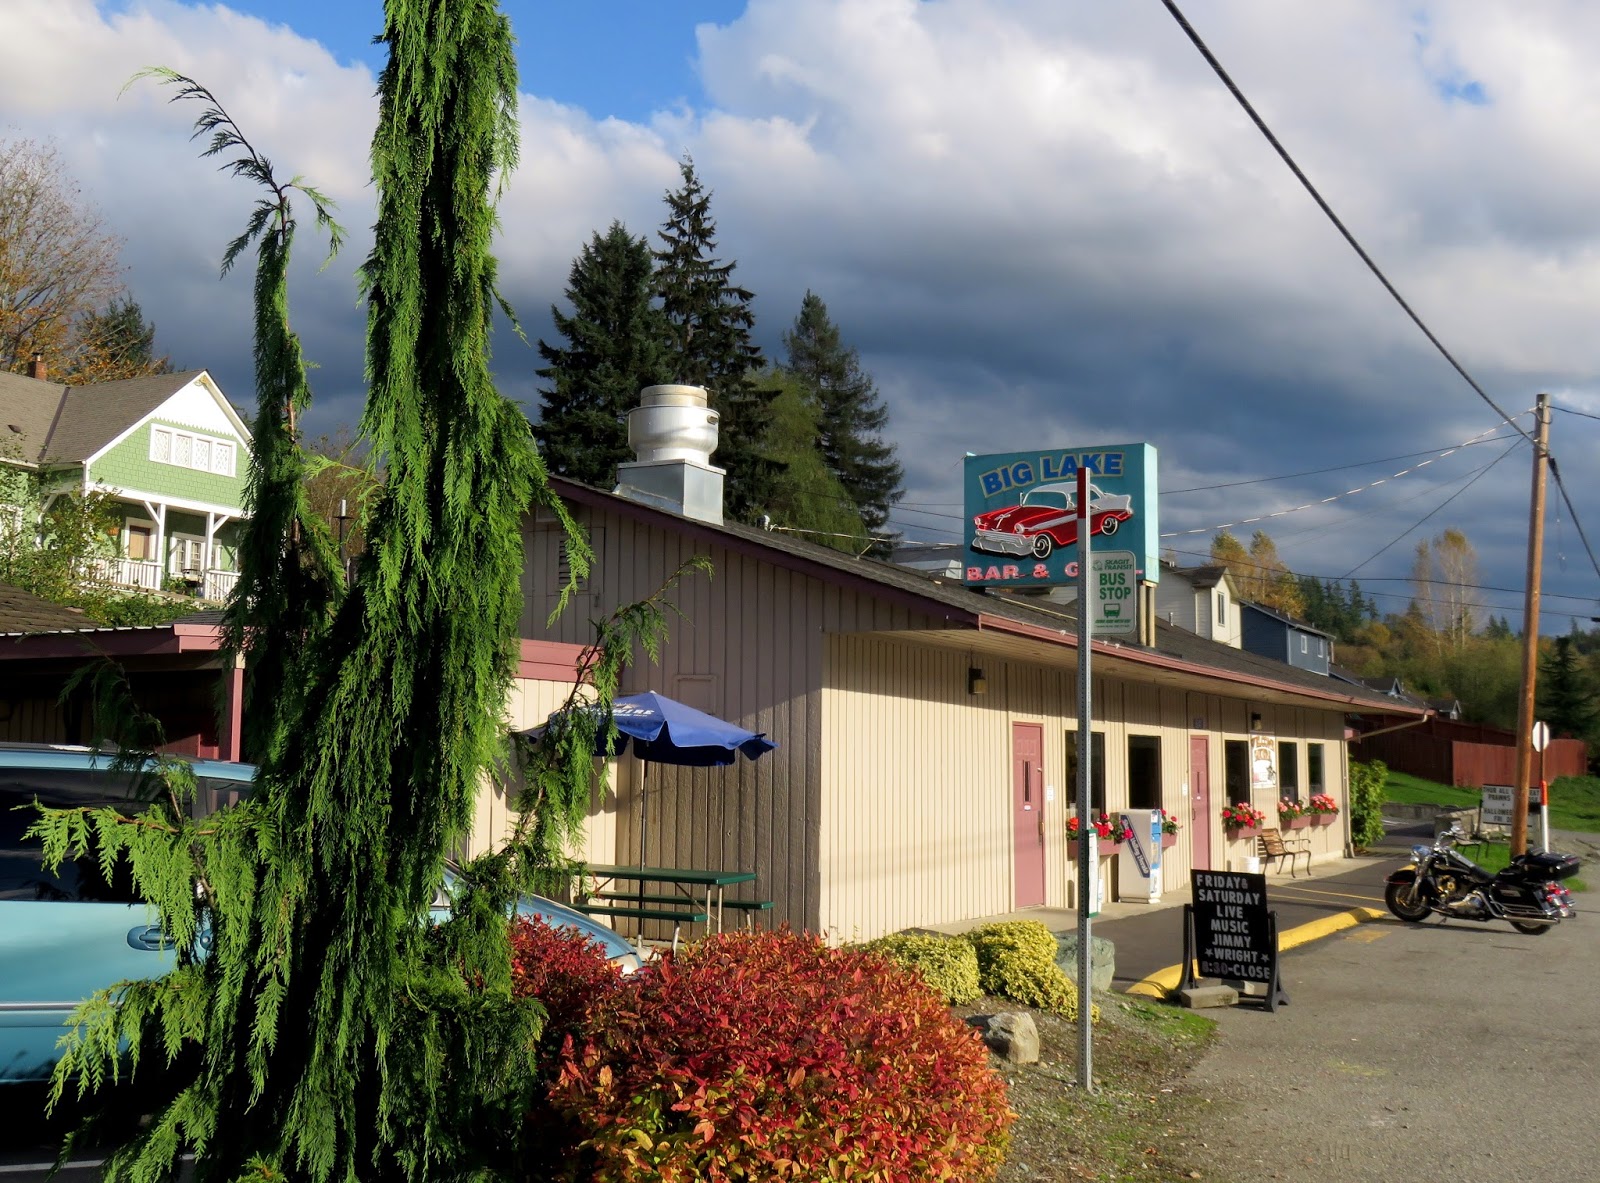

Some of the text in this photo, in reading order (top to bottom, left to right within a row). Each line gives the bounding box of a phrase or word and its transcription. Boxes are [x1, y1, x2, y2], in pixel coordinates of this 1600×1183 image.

[980, 452, 1125, 498] BIG LAKE
[966, 564, 1020, 581] BAR
[1033, 563, 1050, 579] &
[1099, 572, 1126, 586] BUS
[1099, 587, 1132, 600] STOP
[1484, 807, 1513, 816] HALLOWEE
[1198, 889, 1260, 905] SATURDAY
[1216, 905, 1244, 919] LIVE
[1210, 919, 1249, 933] MUSIC
[1212, 933, 1251, 948] JIMMY
[1214, 948, 1258, 963] WRIGHT
